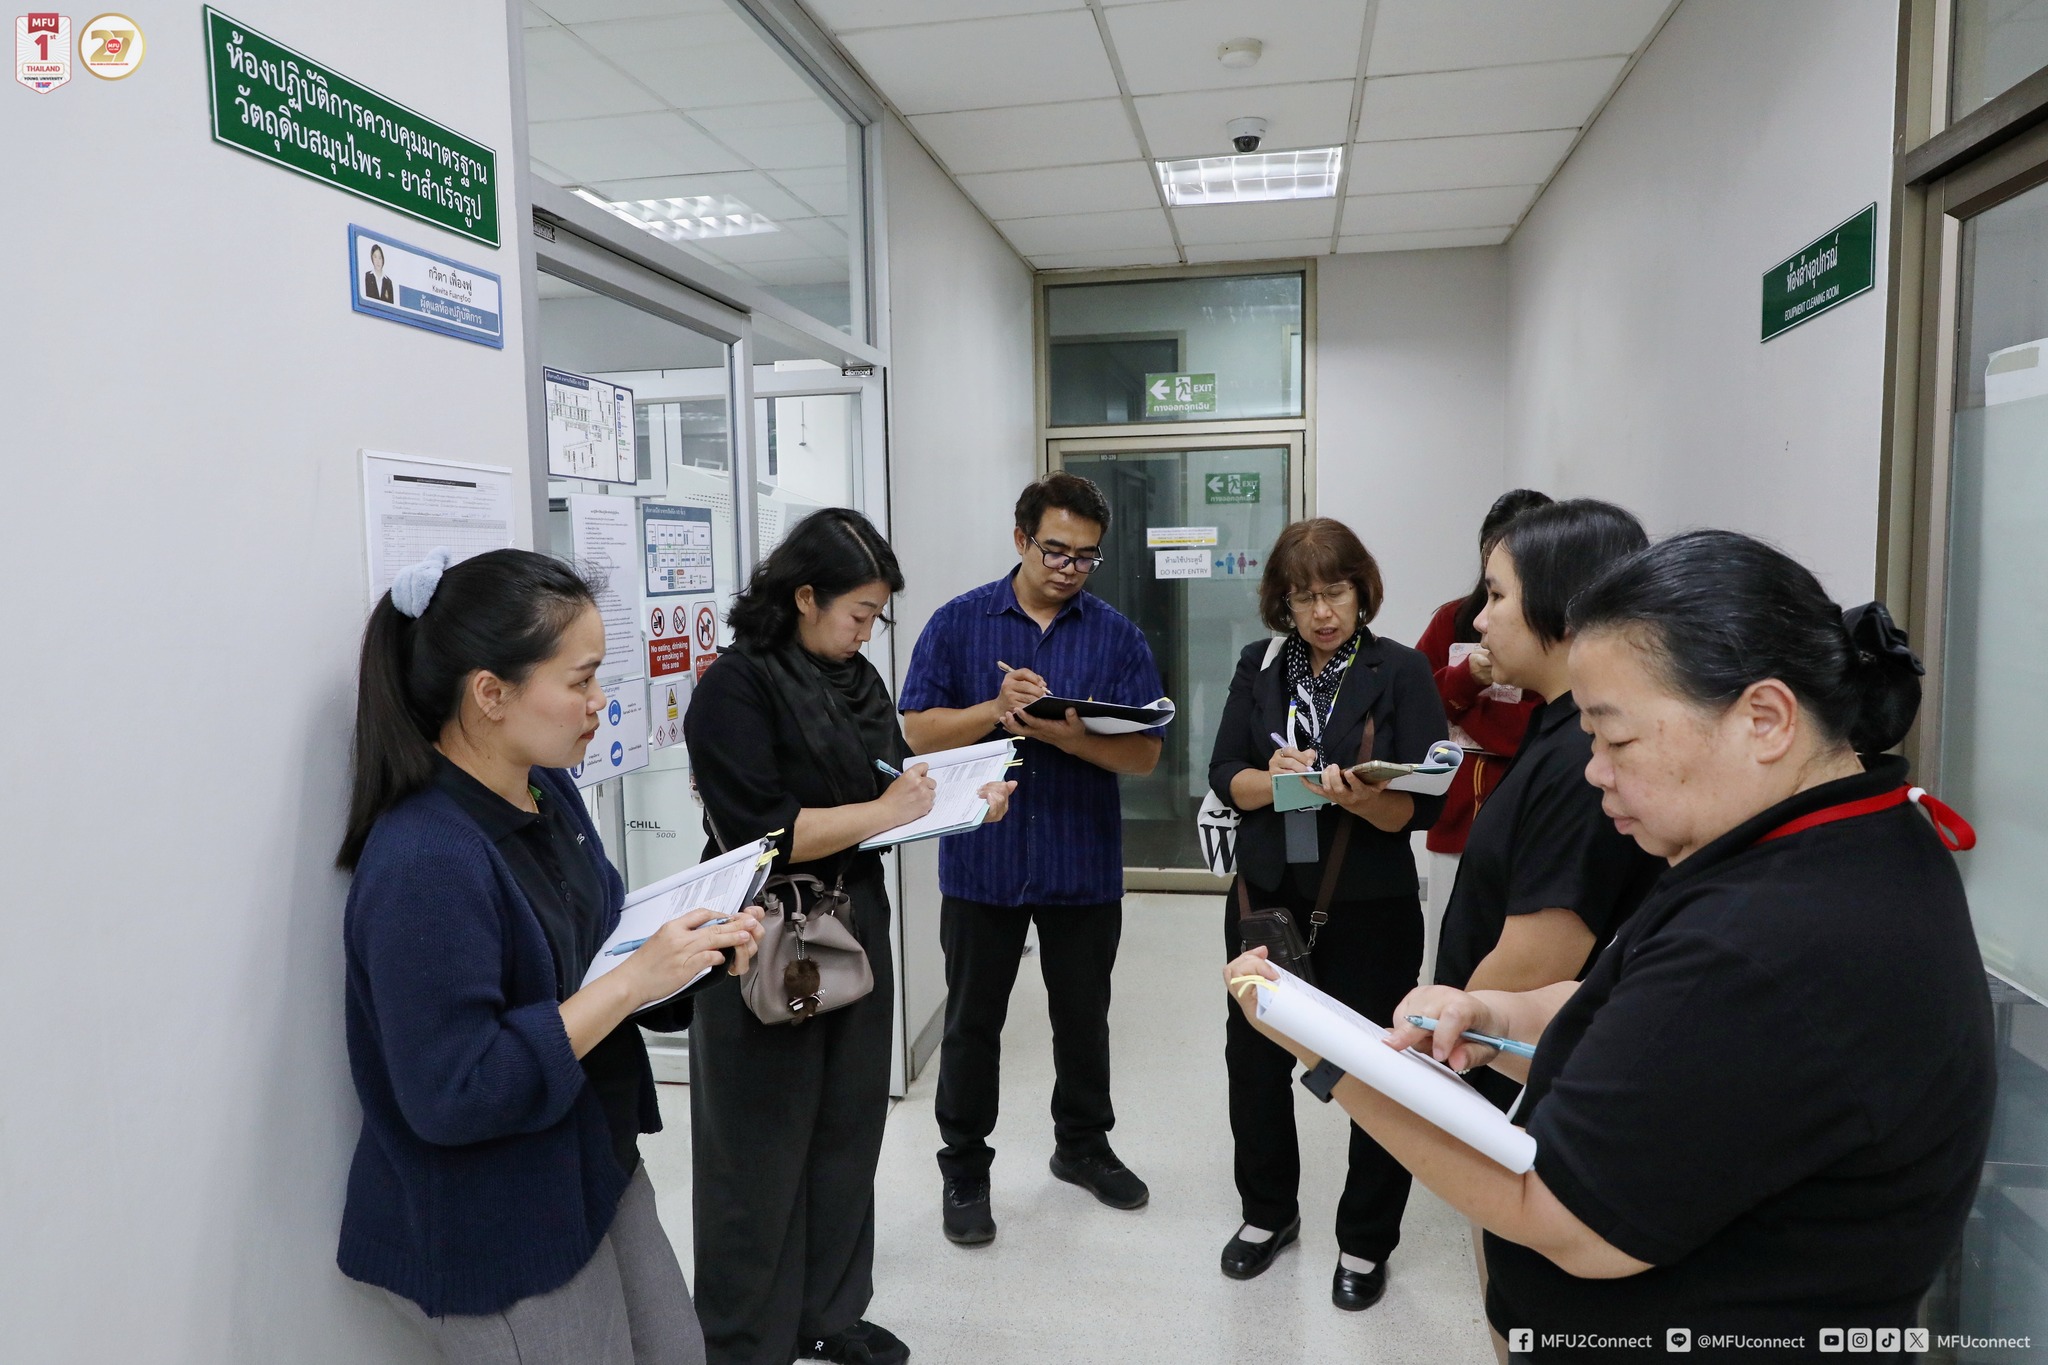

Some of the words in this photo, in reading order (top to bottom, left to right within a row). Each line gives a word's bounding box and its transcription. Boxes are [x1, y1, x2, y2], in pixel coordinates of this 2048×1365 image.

[226, 30, 488, 188] ห้องปฏิบัติการควบคุมมาตรฐาน
[234, 84, 382, 180] วัตถุดิบสมุนไพร
[400, 168, 482, 228] ยาสำเร็จรูป
[1787, 233, 1839, 293] ห้องล้างอุปกรณ์
[432, 285, 448, 296] Kawita
[1784, 301, 1806, 321] EQUIPMENT
[1806, 291, 1825, 310] CLEANING
[1826, 284, 1839, 300] ROOM
[420, 294, 482, 324] ผู้ดูแลห้องปฏิบัติการ
[1193, 384, 1214, 393] EXIT
[1153, 402, 1210, 413] ทางออกฉุกเฉิน
[1242, 480, 1258, 488] EXIT
[1187, 567, 1208, 575] ENTRY
[651, 645, 657, 653] No
[672, 641, 688, 650] drinking
[662, 652, 679, 661] smoking
[662, 662, 670, 671] this
